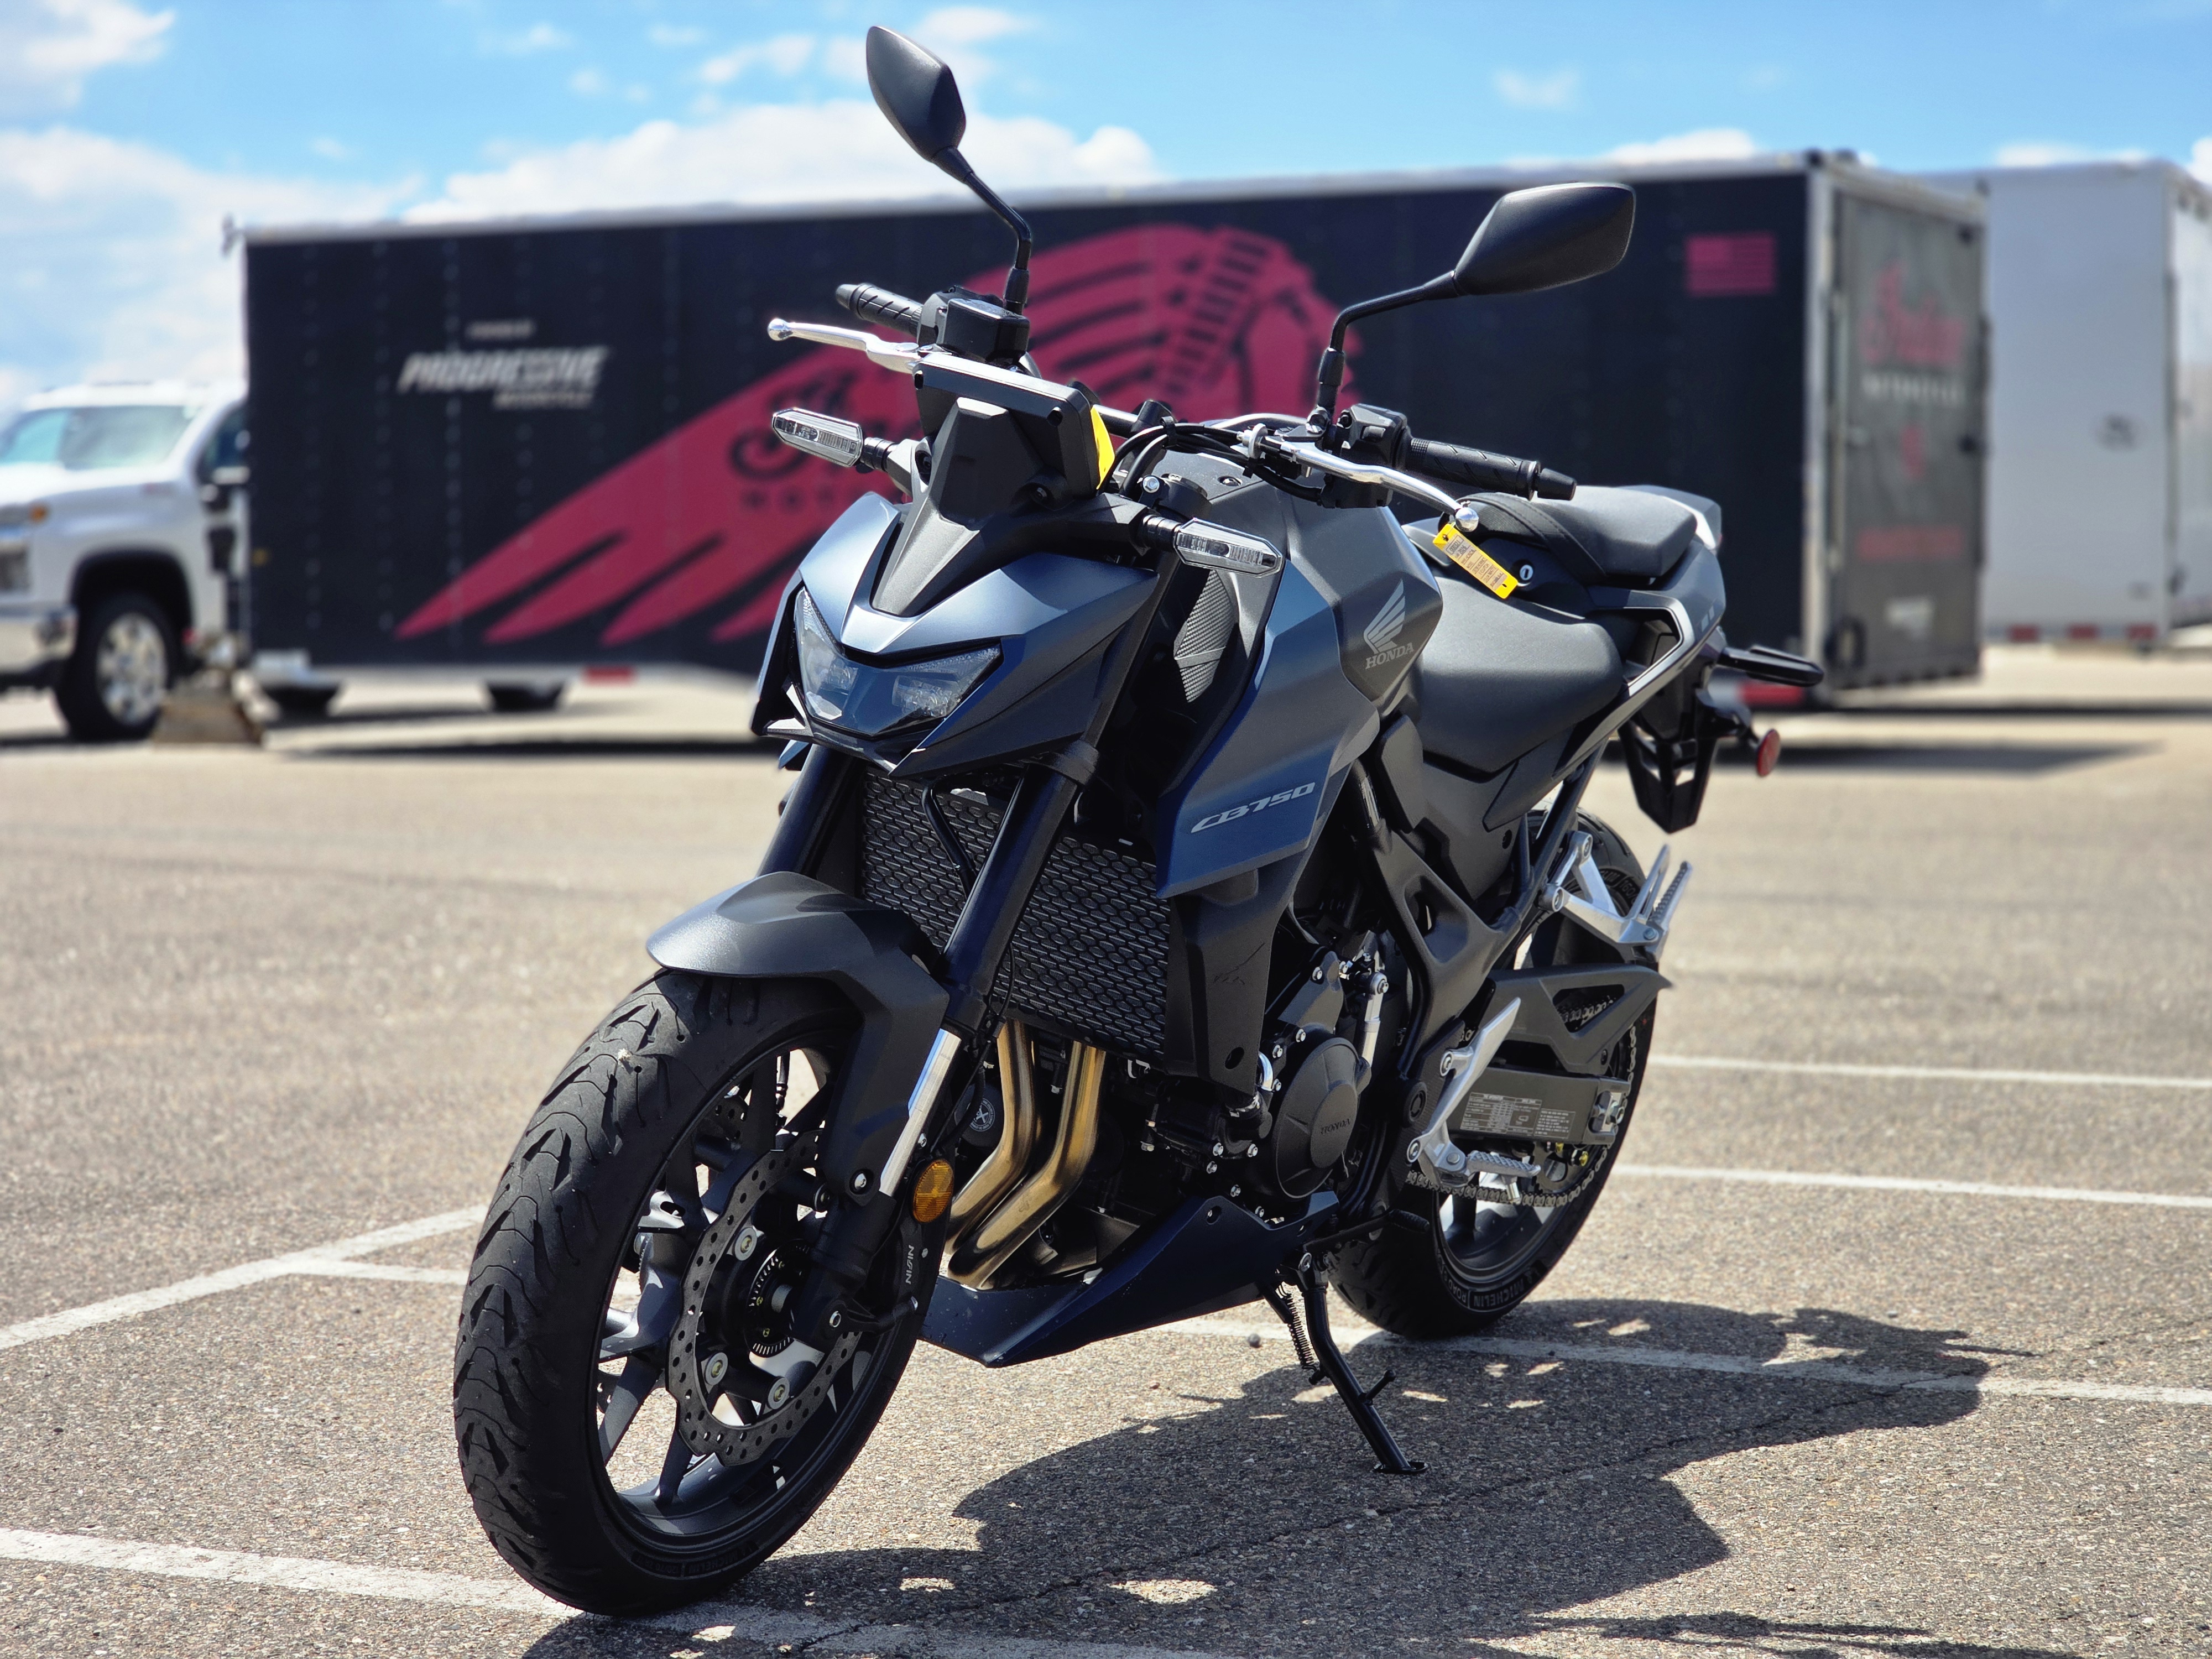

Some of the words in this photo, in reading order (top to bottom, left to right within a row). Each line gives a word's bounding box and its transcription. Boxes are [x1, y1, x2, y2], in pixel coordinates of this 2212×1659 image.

[1365, 642, 1414, 670] HONDA
[1191, 782, 1316, 833] CB750
[905, 1245, 915, 1285] NISSIN
[1448, 1279, 1467, 1303] ROAD
[1474, 1278, 1525, 1307] MICHELIN
